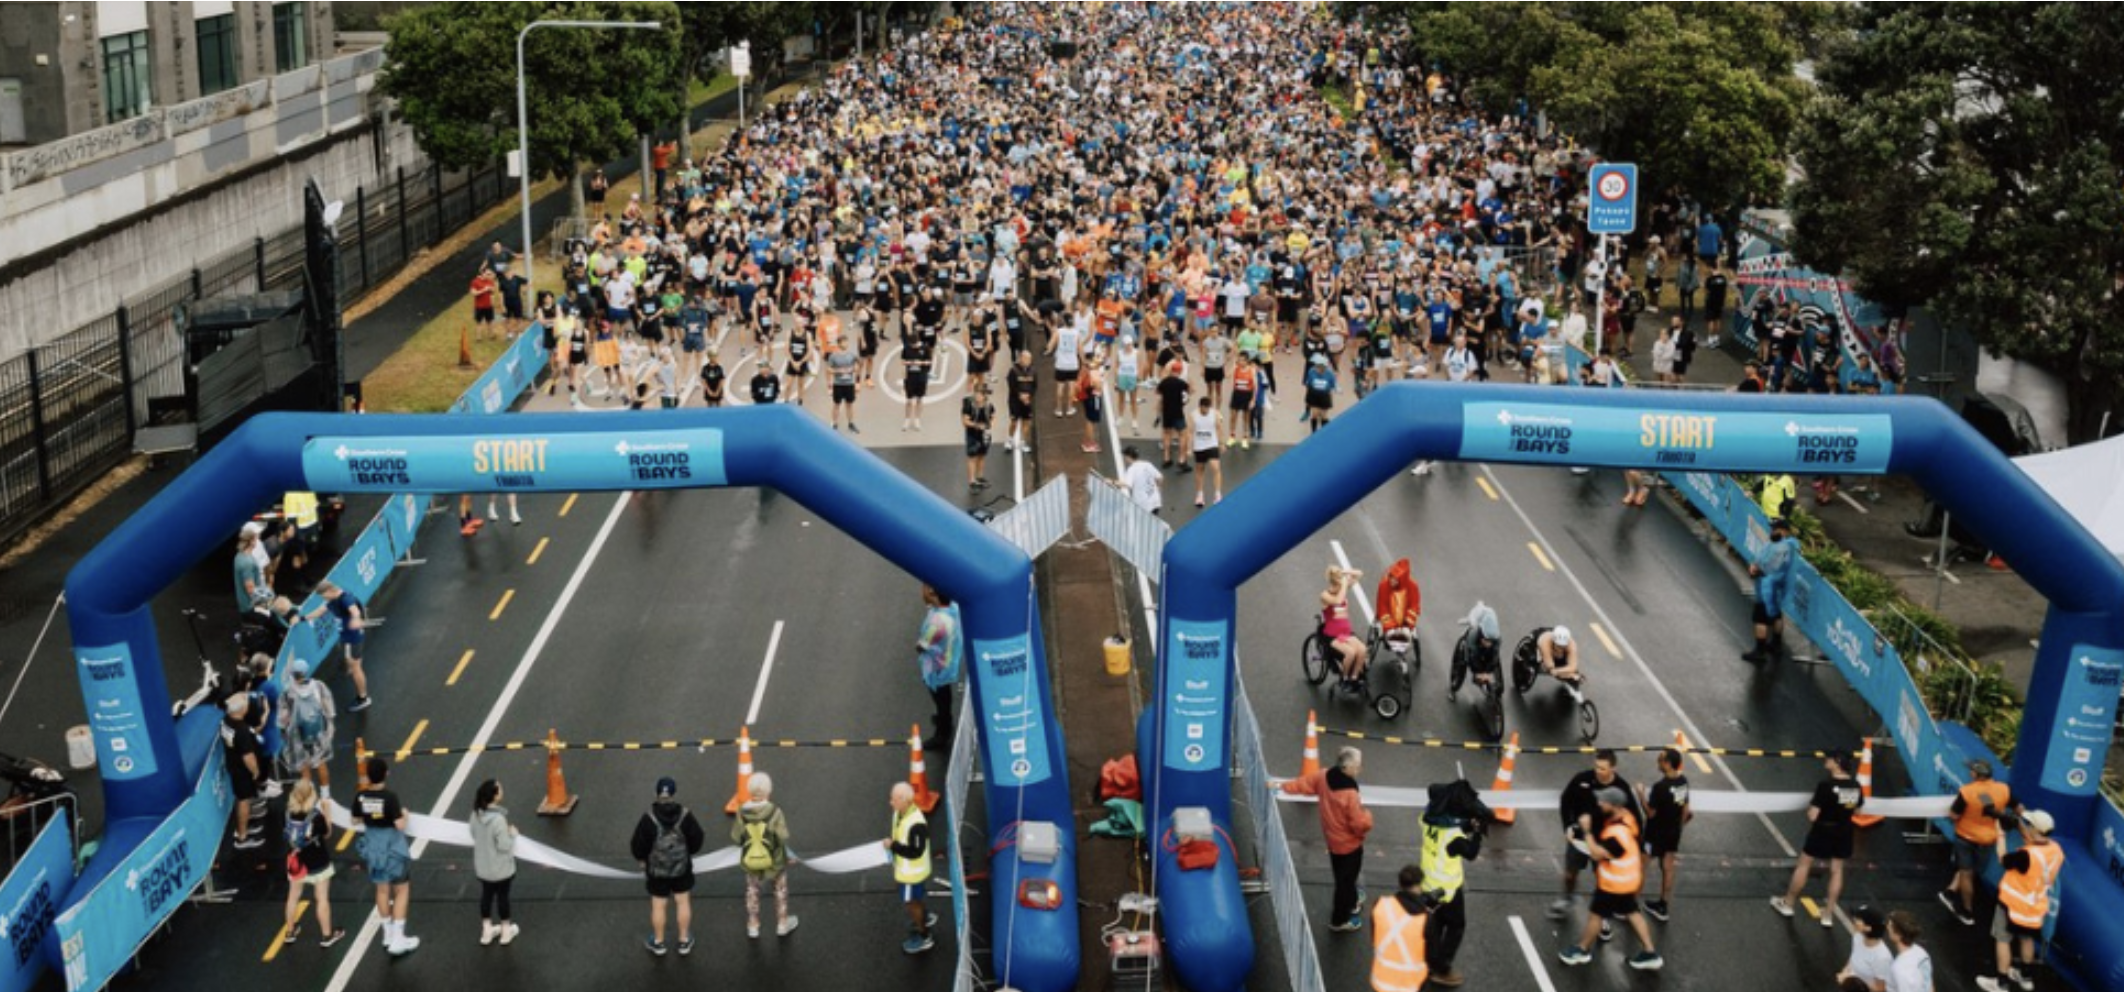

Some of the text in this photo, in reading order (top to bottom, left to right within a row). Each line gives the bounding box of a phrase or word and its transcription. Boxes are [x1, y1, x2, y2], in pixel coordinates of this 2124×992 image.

[1605, 180, 1621, 192] 30
[1511, 425, 1572, 439] ROUND
[1641, 414, 1717, 449] START
[1516, 438, 1570, 454] BAYS
[1799, 435, 1858, 448] ROUND
[474, 440, 549, 473] START
[630, 452, 689, 466] ROUND
[1803, 448, 1857, 463] BAYS
[349, 458, 407, 472] ROUND
[358, 472, 411, 485] BAYS
[638, 466, 691, 480] BAYS
[150, 859, 190, 914] BAYS
